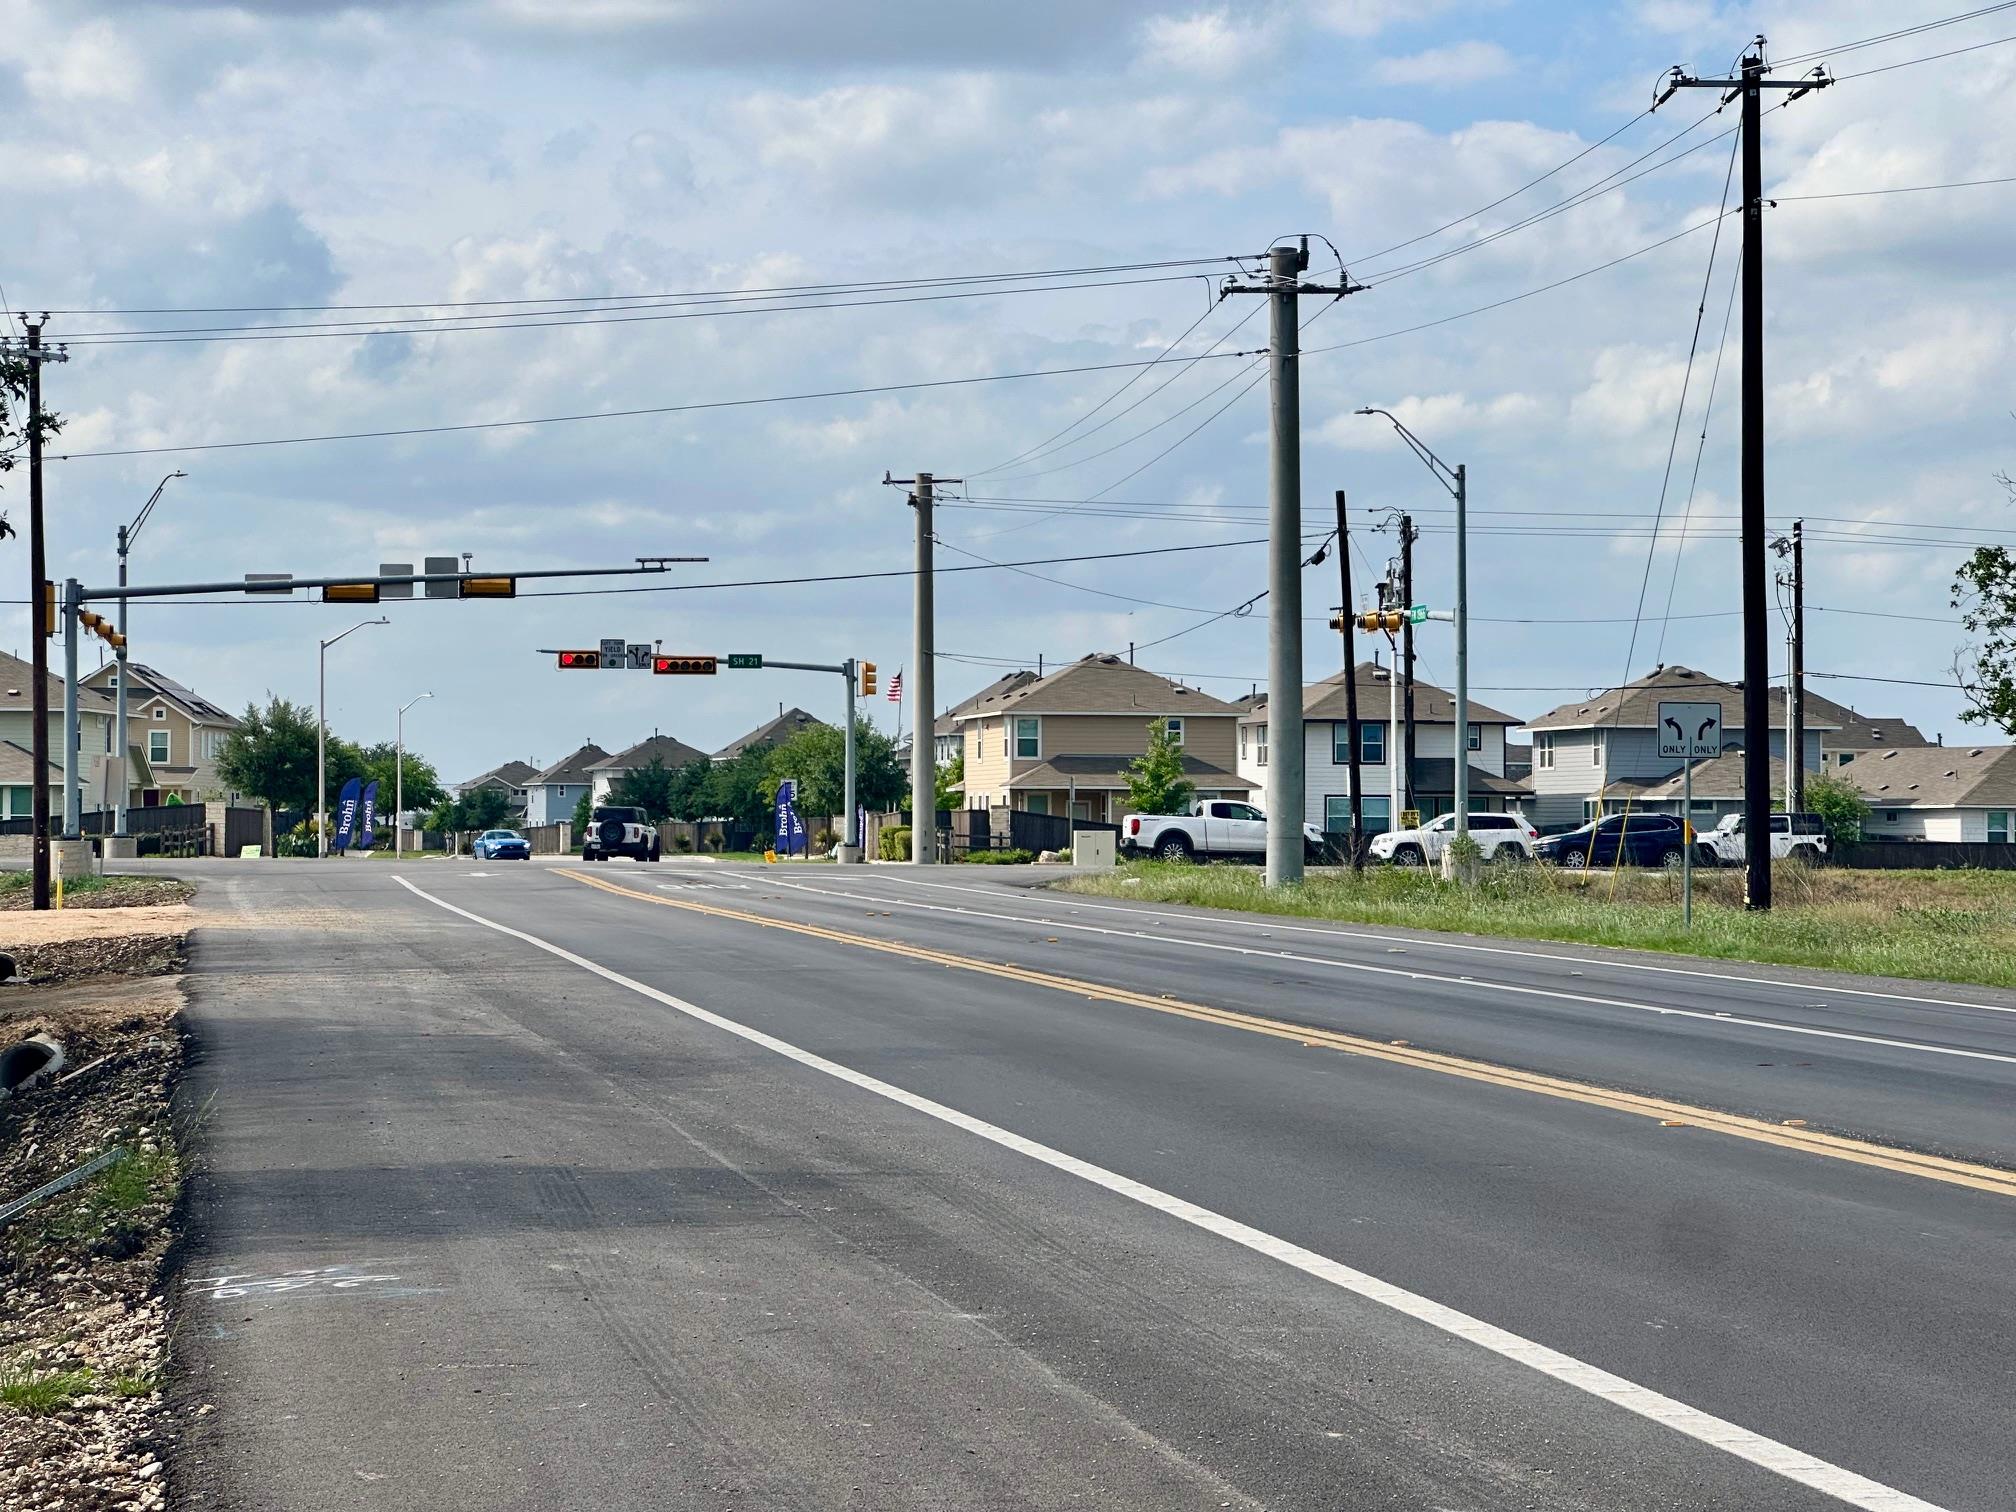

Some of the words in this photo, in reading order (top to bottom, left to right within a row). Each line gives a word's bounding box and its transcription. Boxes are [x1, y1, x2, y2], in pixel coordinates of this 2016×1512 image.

[1662, 745, 1686, 754] ONLY
[1694, 745, 1718, 754] ONLY
[339, 799, 355, 835] Brohn
[364, 800, 372, 833] Brohn
[779, 803, 788, 837] Brohn
